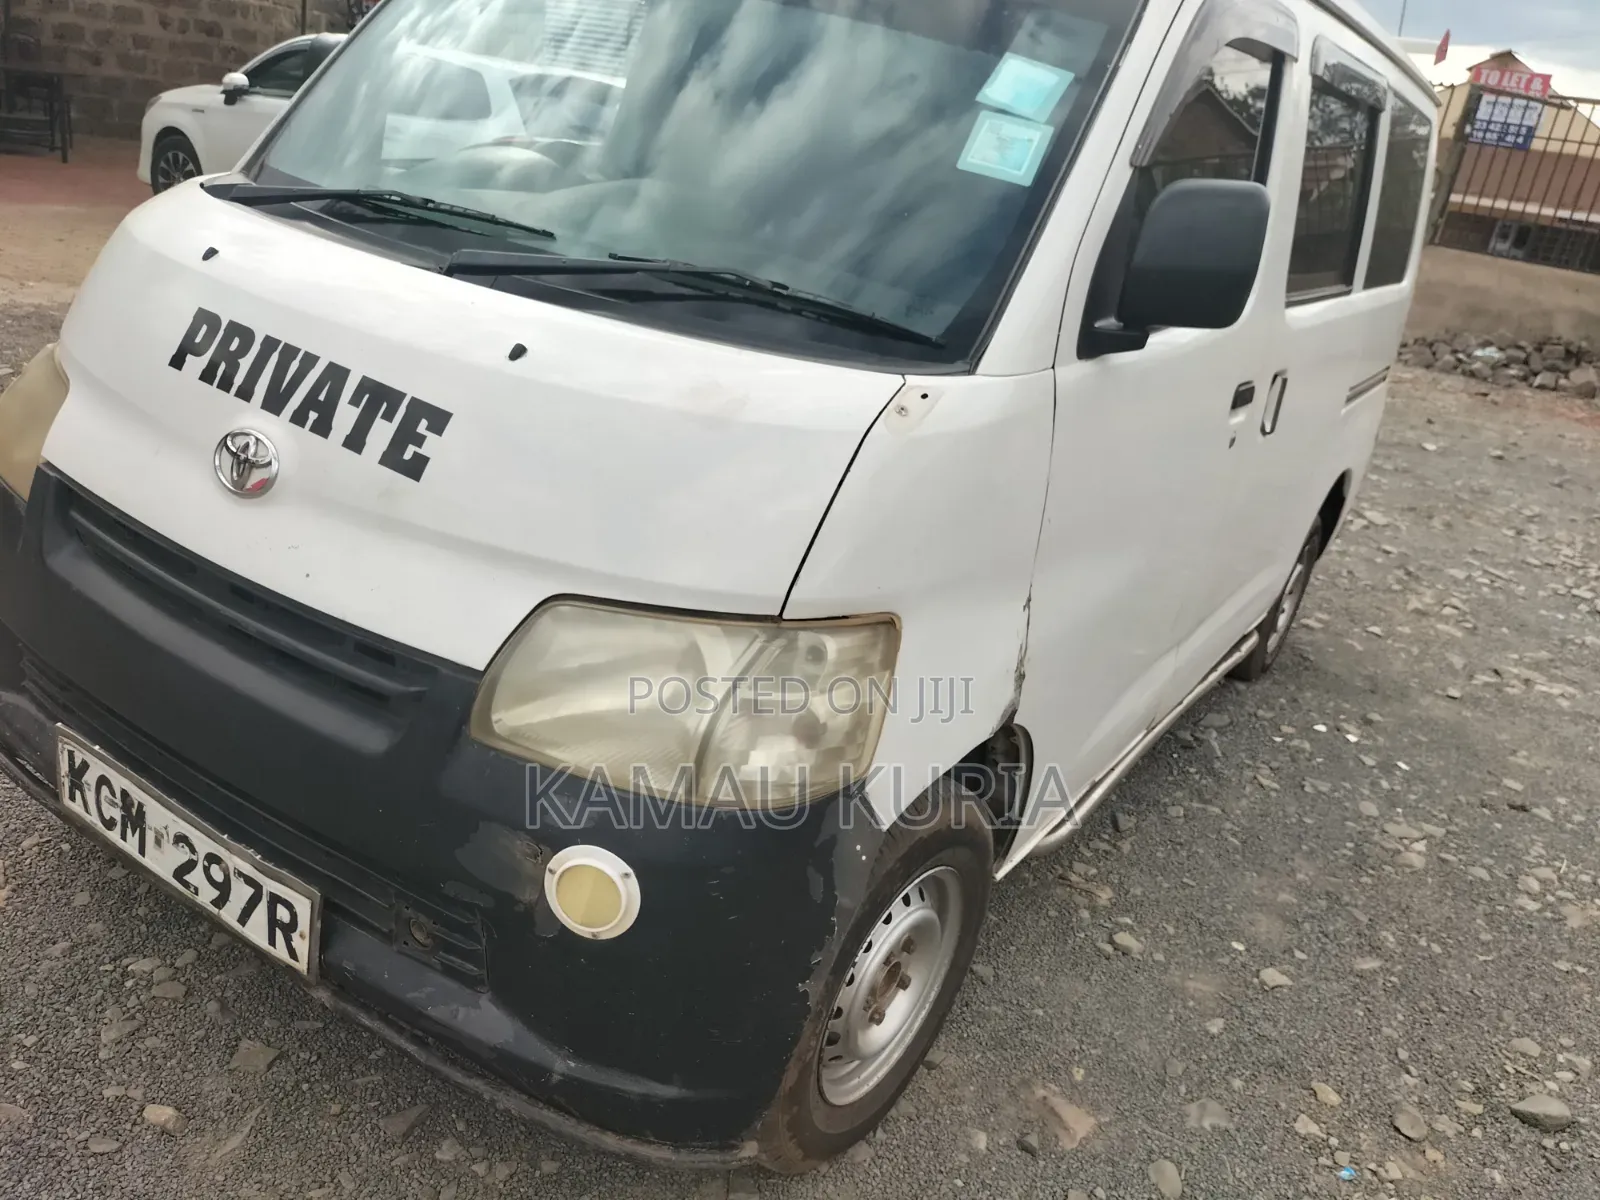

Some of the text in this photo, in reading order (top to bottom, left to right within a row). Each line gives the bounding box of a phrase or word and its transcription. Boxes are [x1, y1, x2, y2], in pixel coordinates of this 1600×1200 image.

[1479, 69, 1500, 86] TO
[1501, 71, 1530, 89] LET
[168, 307, 453, 483] PRIVATE
[67, 748, 300, 963] KCM 297R
